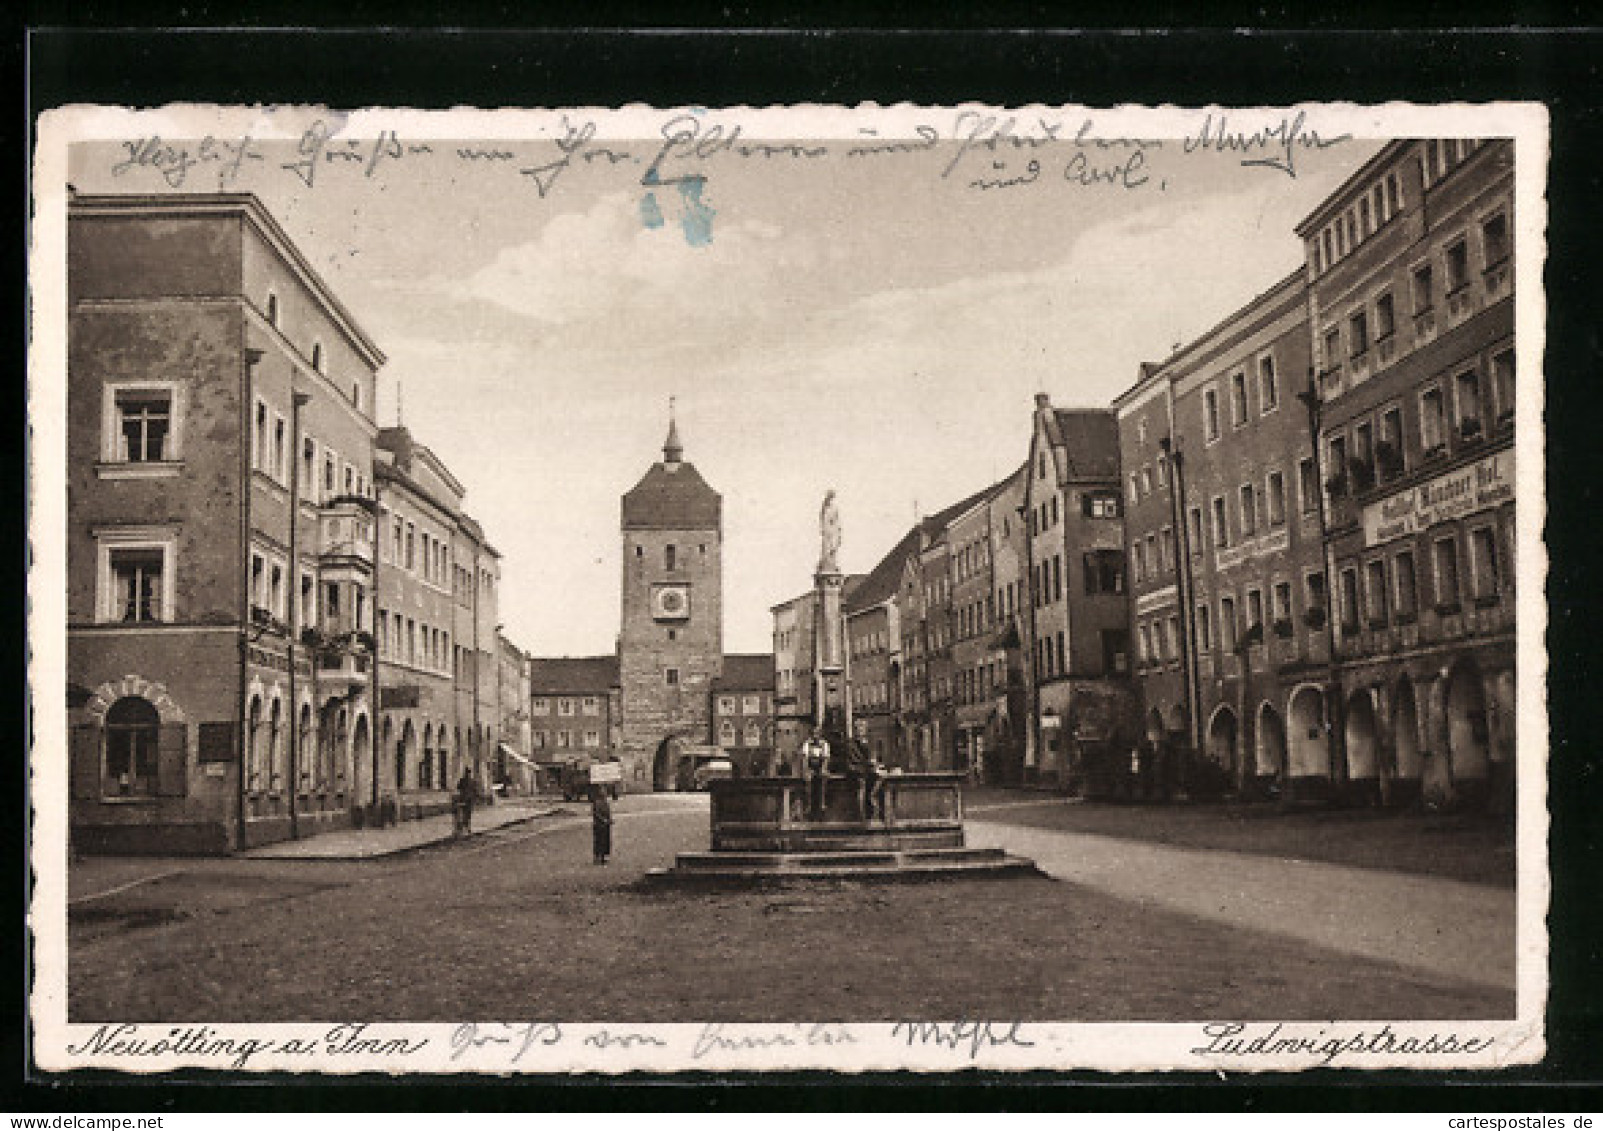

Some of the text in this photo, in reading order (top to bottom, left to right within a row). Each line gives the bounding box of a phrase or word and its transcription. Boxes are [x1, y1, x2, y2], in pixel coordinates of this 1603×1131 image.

[67, 1024, 275, 1067] Neuötting
[323, 1022, 430, 1055] Inn
[1189, 1022, 1496, 1065] Ludwigstrasse
